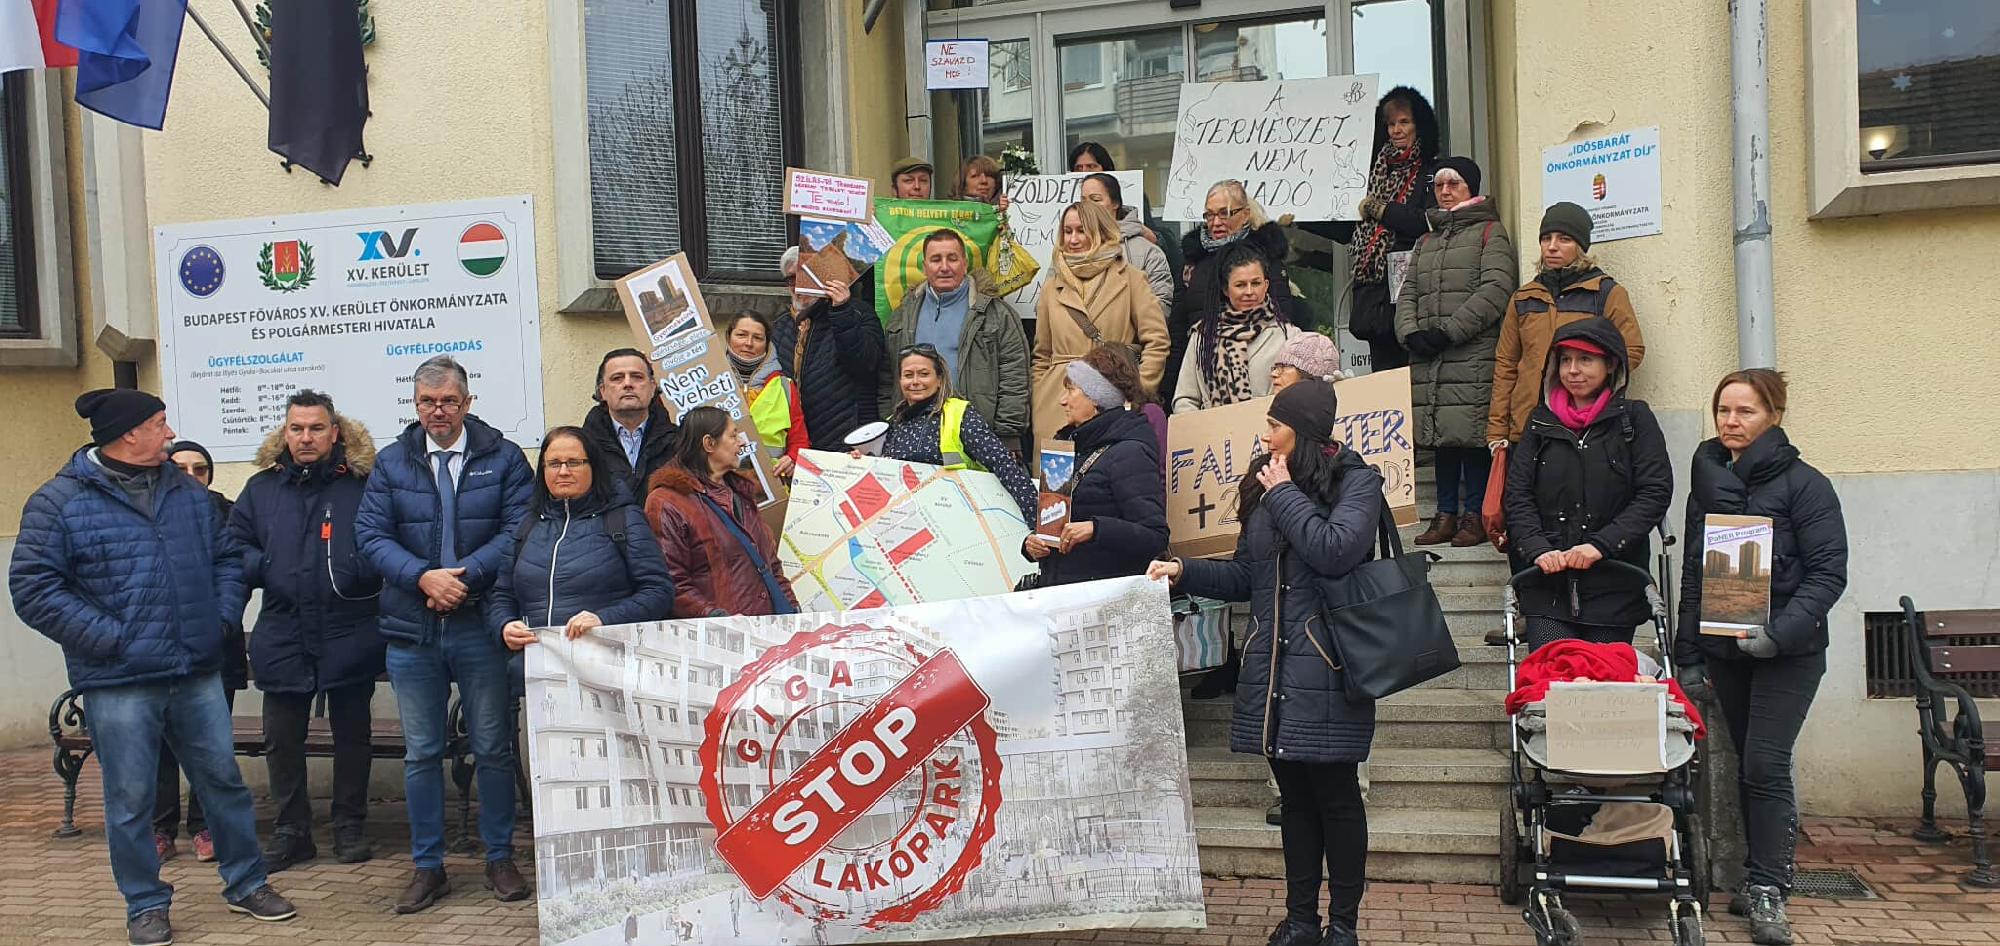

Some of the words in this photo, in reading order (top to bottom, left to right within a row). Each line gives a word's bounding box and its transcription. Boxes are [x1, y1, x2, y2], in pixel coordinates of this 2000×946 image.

[930, 57, 976, 66] SZAVAZD
[941, 43, 958, 56] NE
[1265, 84, 1286, 112] A
[1546, 149, 1632, 173] ÖNKORMÁNYZAT
[346, 268, 369, 281] XV.
[371, 262, 430, 279] KERÜLET
[184, 311, 247, 327] BUDAPEST
[250, 306, 306, 322] FŐVÁROS
[310, 305, 330, 318] XV.
[332, 298, 387, 317] KERÜLET
[389, 290, 508, 313] ÖNKORMÁNYZATA
[251, 325, 266, 340] ÉS
[269, 318, 371, 339] POLGÁRMESTERI
[374, 316, 436, 333] HIVATALA
[208, 351, 305, 368] ÜGYFÉLSZOLGÁLAT
[386, 339, 483, 356] ÜGYFÉLFOGADÁS
[664, 366, 708, 397] Nem
[675, 374, 734, 407] veheti
[736, 660, 853, 764] GIGA
[772, 706, 917, 847] STOP
[812, 754, 962, 892] LAKÓPARK
